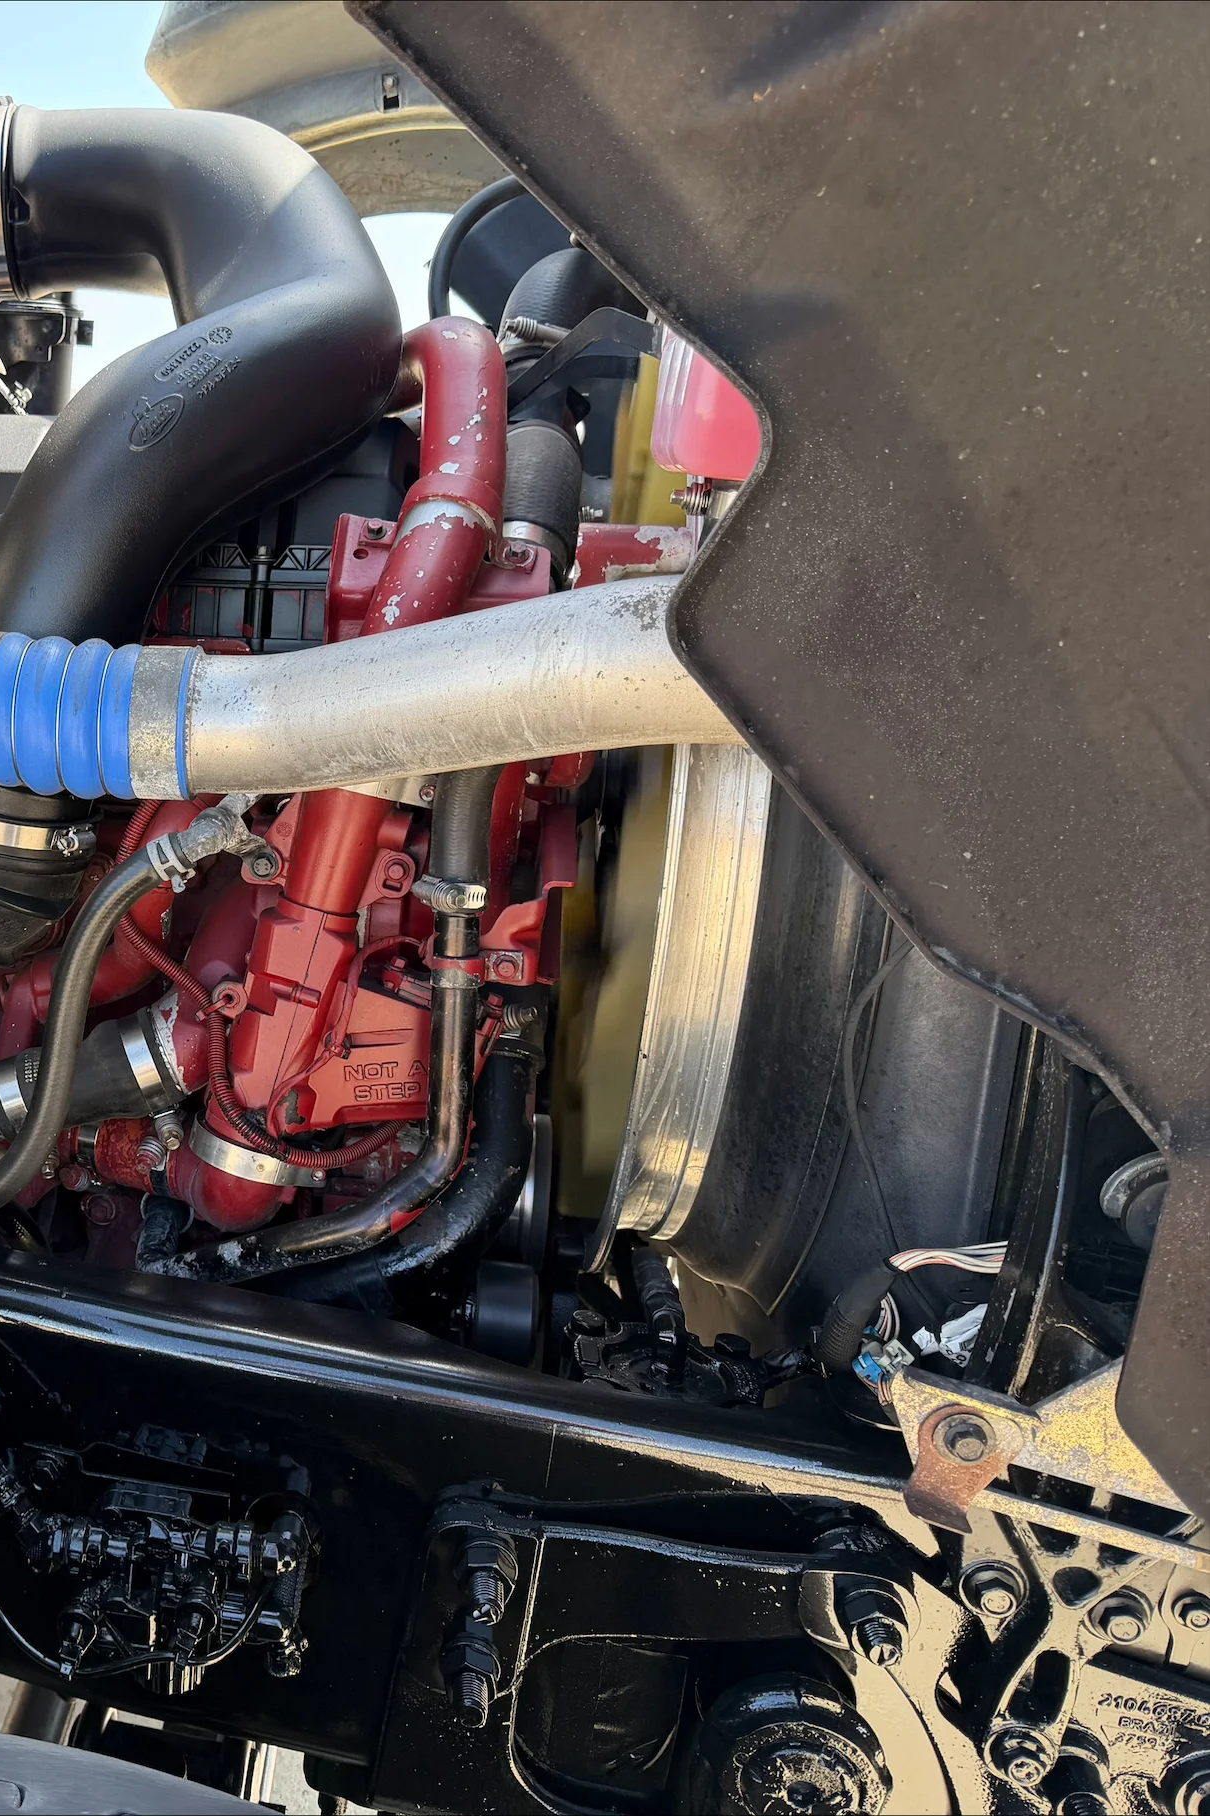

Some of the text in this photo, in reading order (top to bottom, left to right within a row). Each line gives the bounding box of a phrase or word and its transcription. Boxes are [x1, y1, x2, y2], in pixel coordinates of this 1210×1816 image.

[344, 1060, 428, 1081] NOT A
[354, 1082, 421, 1102] STEP
